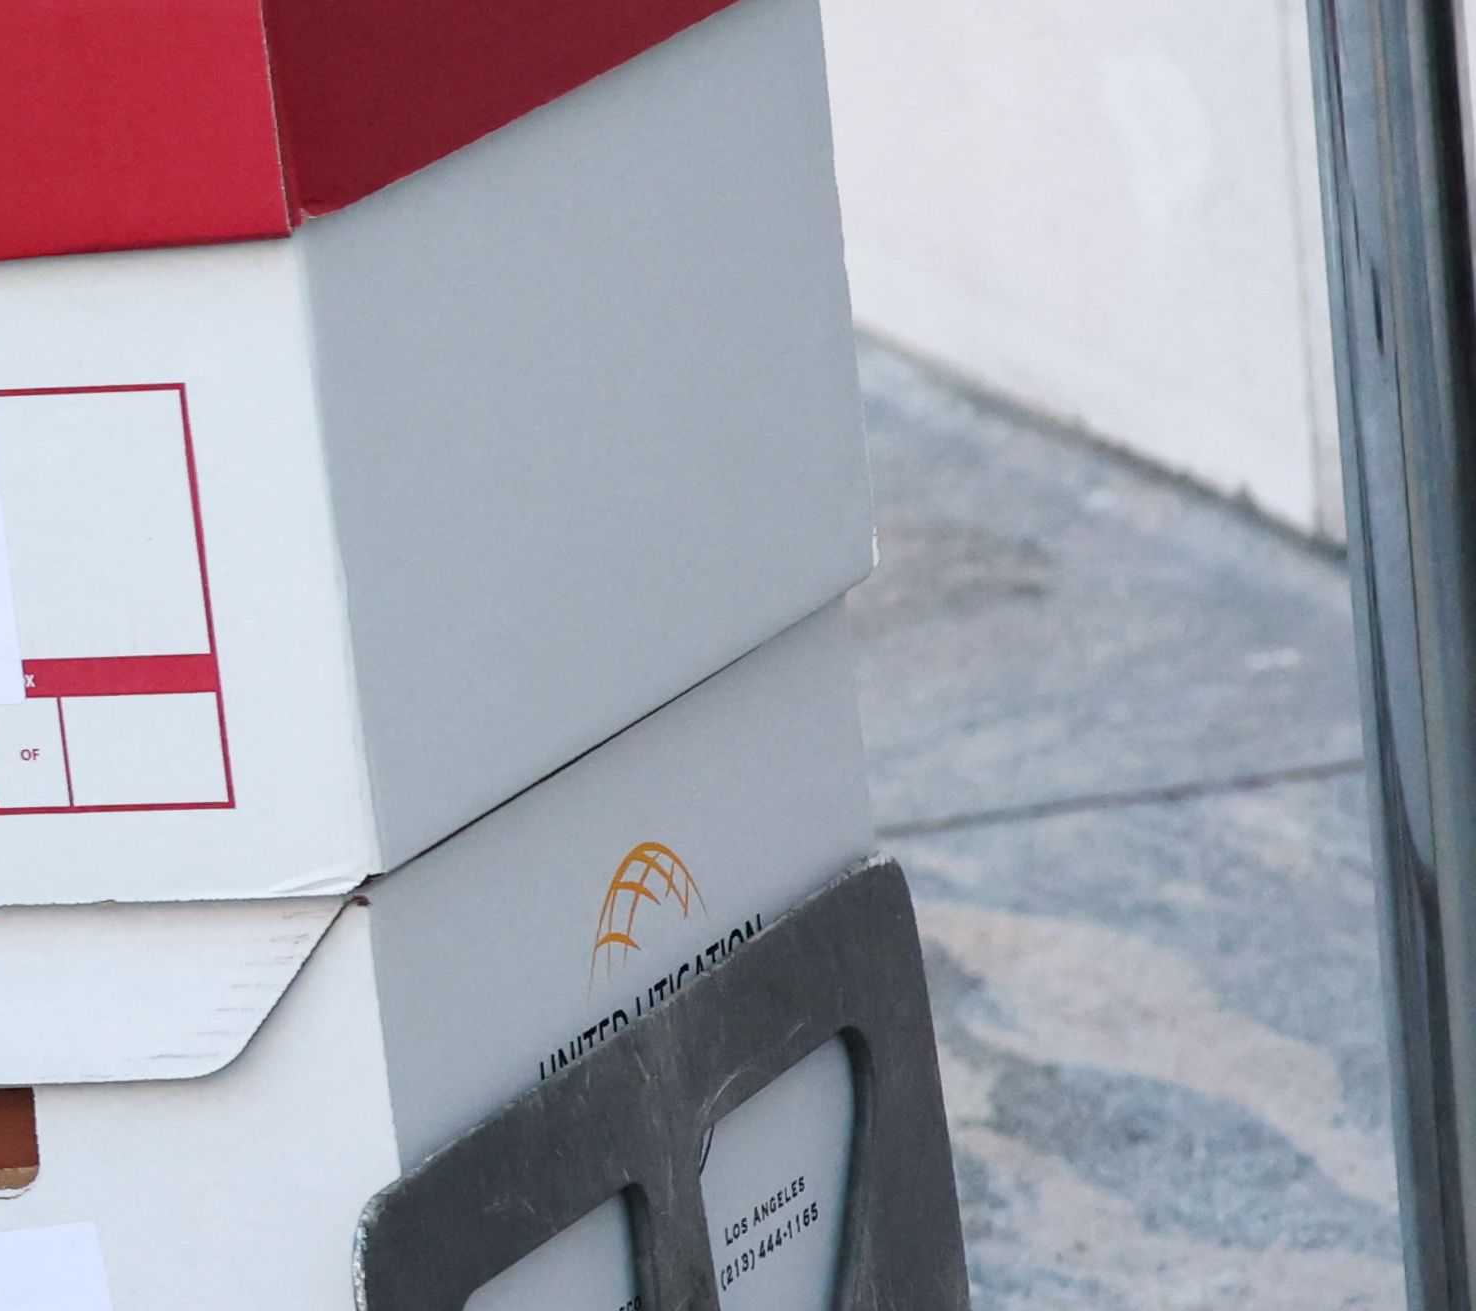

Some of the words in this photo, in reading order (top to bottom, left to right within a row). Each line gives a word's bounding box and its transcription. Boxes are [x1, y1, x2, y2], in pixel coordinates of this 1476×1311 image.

[20, 748, 40, 761] OF
[753, 1176, 805, 1226] ANGELES
[721, 1249, 755, 1291] (213)
[759, 1202, 818, 1258] 444-1165
